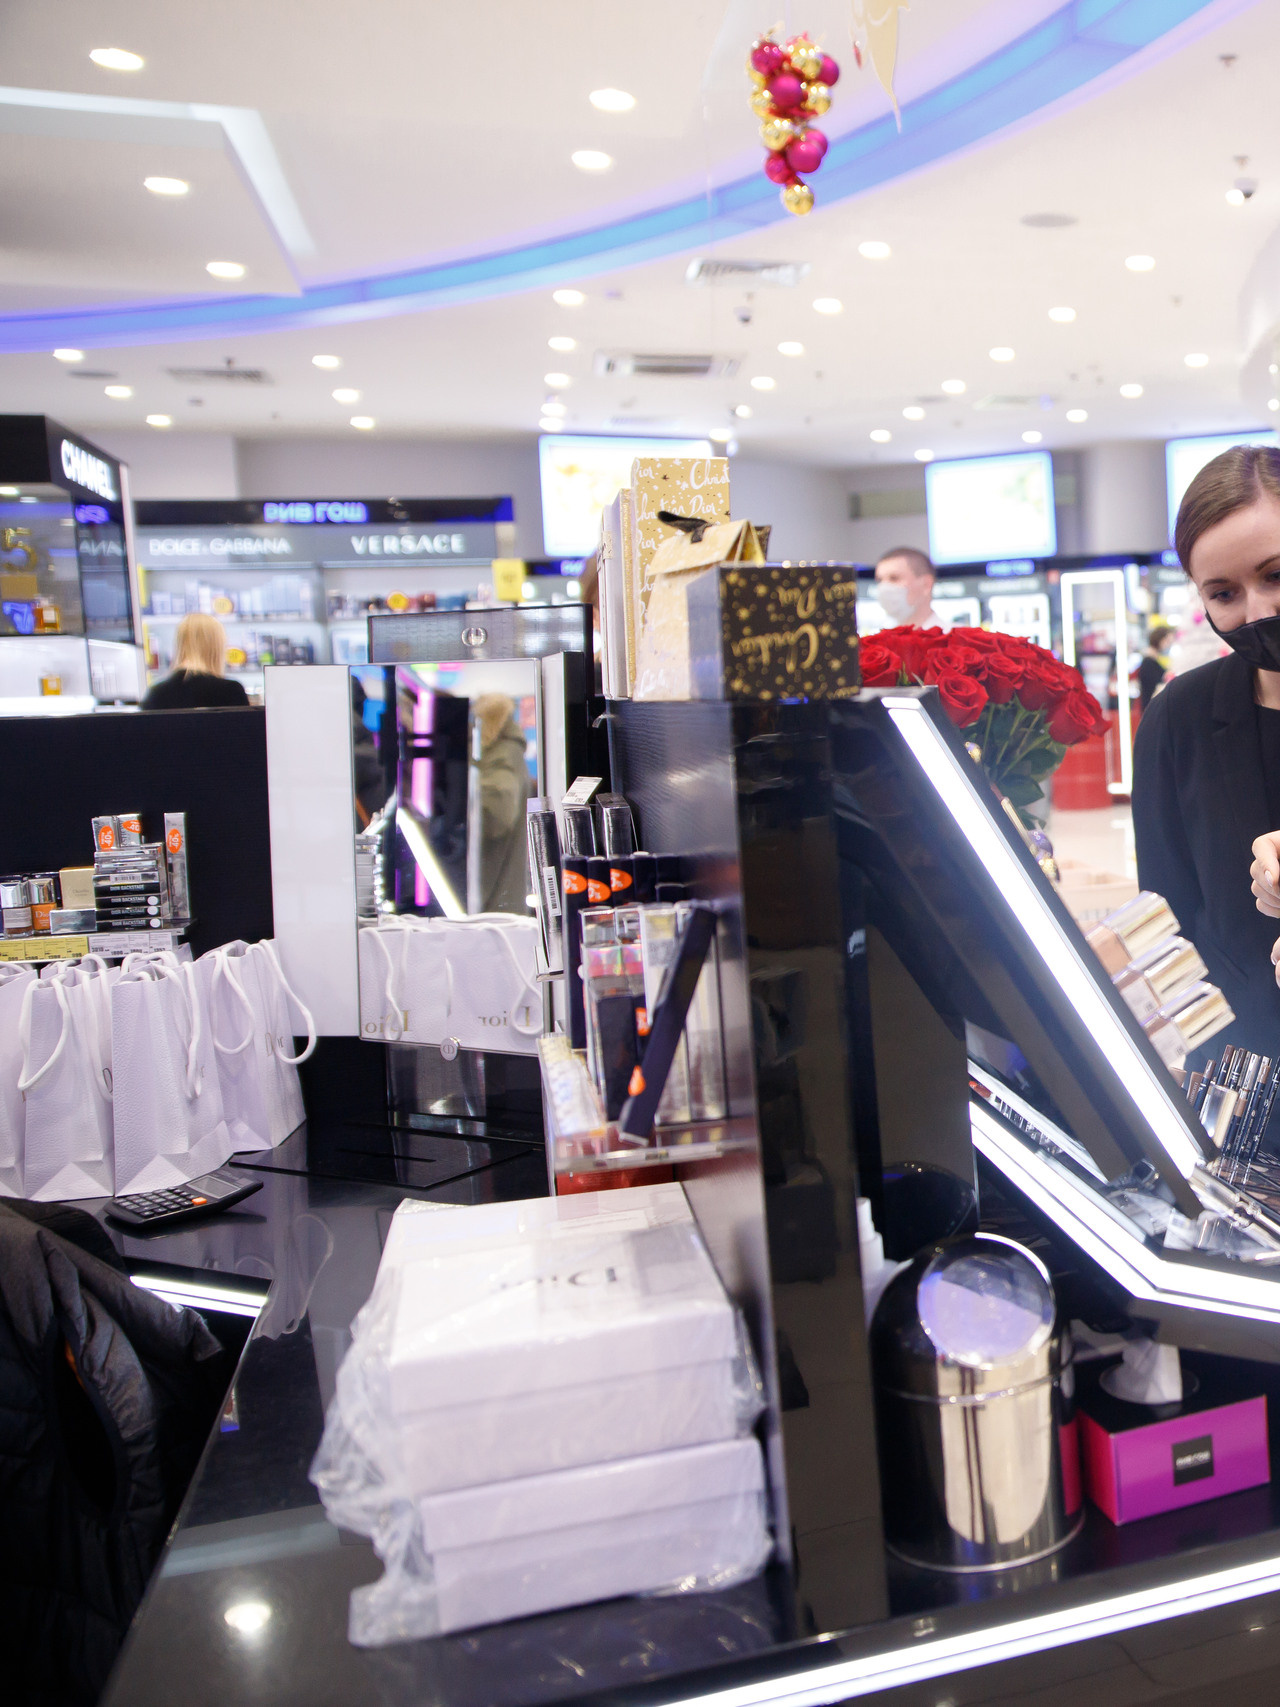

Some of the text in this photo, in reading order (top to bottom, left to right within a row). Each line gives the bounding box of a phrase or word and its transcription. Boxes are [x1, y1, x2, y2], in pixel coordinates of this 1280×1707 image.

[61, 438, 116, 500] CHANEL
[315, 501, 369, 523] ГОШ
[209, 537, 293, 555] GABBANA
[351, 533, 466, 555] VERSACE
